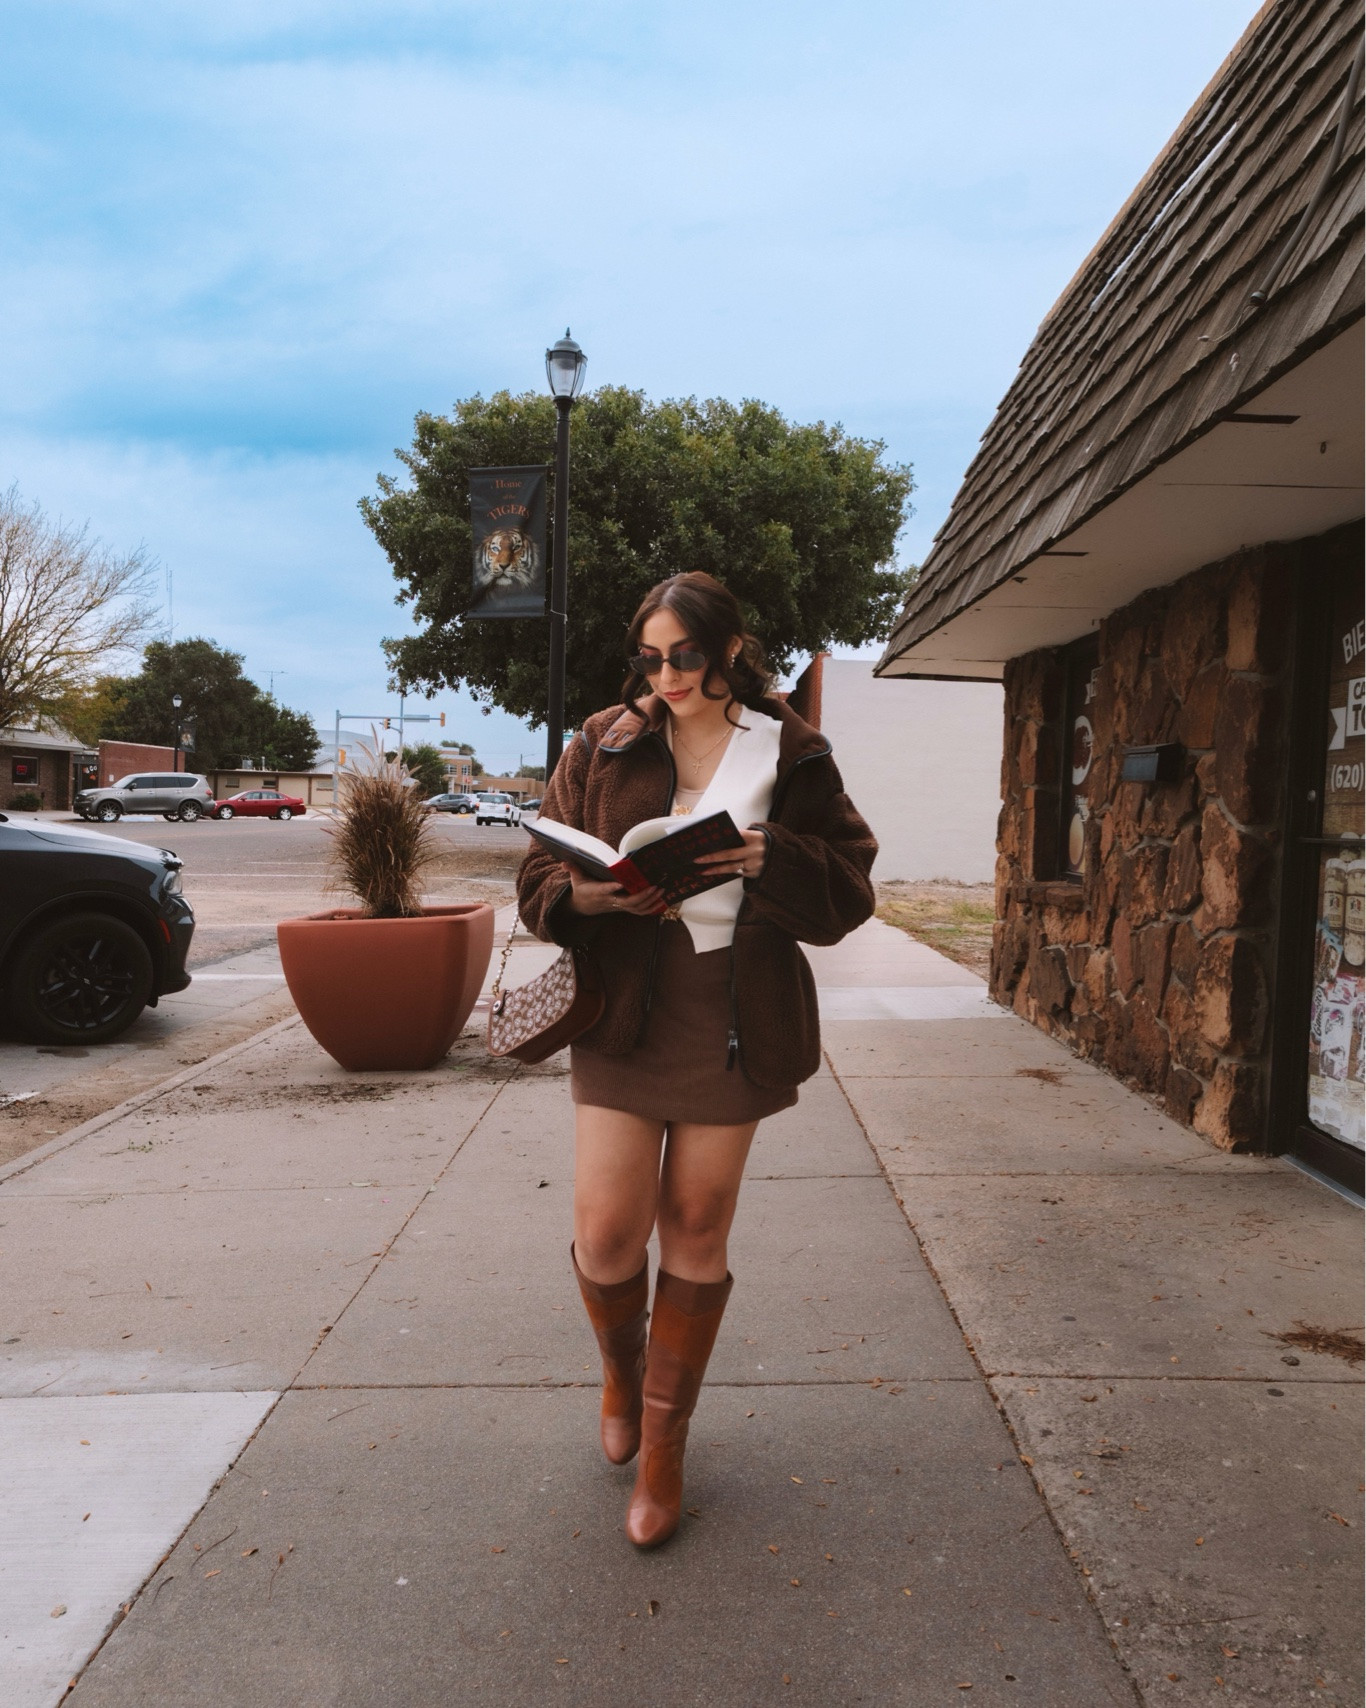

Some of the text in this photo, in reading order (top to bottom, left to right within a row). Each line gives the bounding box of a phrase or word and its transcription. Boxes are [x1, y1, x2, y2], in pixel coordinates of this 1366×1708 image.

[495, 480, 522, 488] Home
[487, 504, 530, 520] TIGERS
[1331, 762, 1364, 792] (620)
